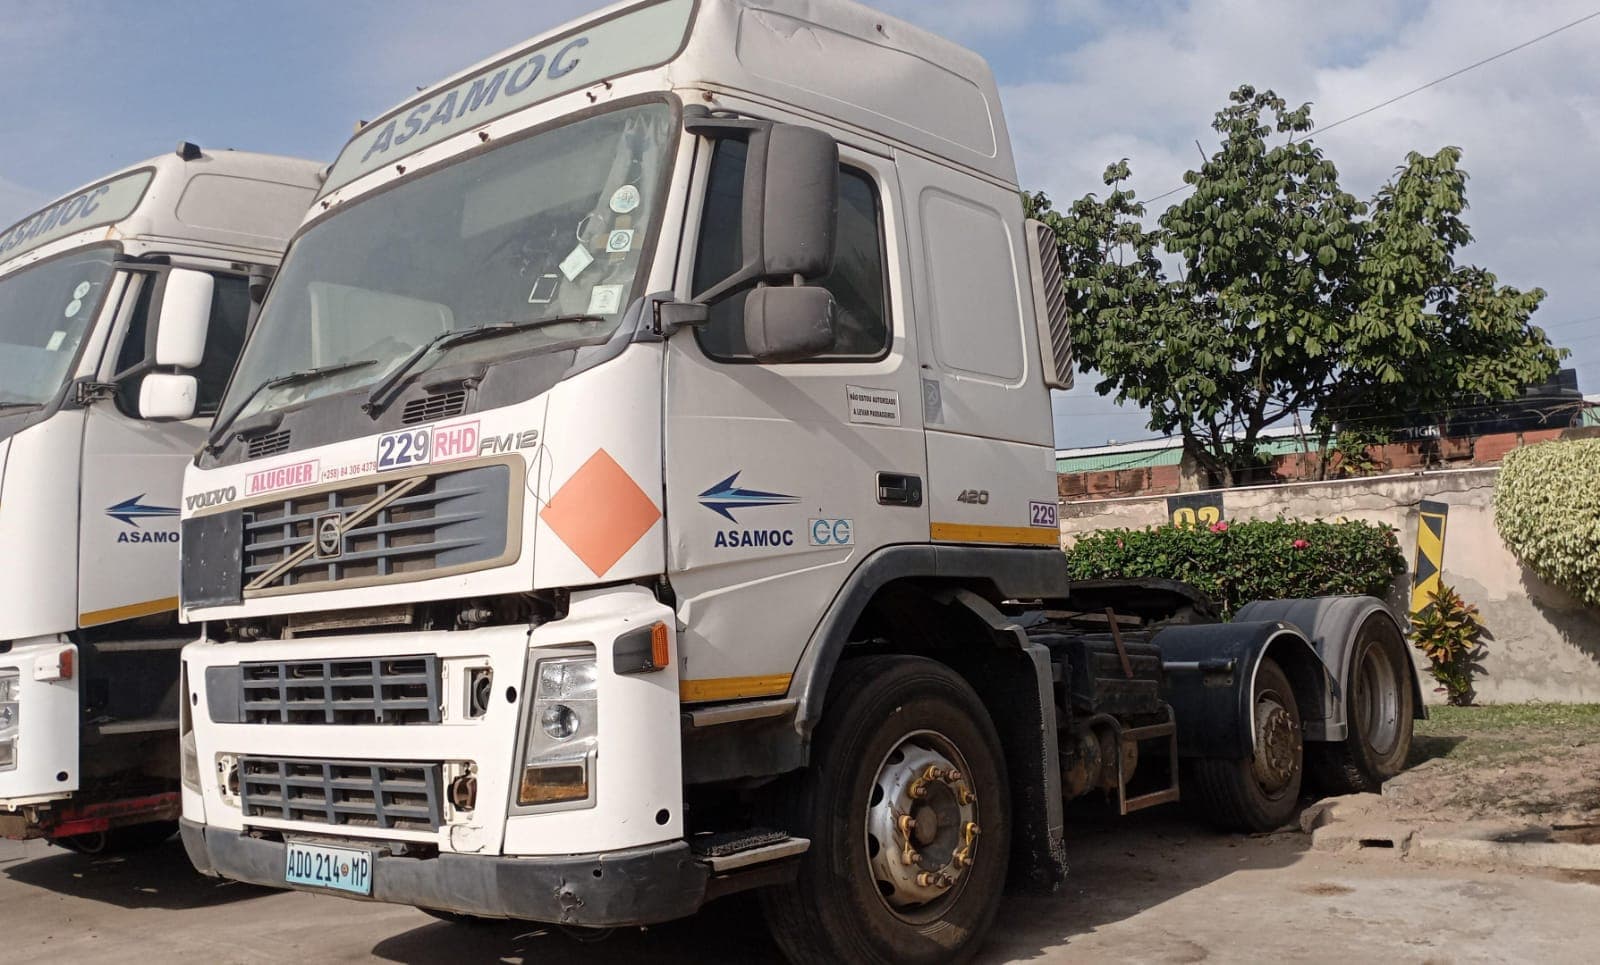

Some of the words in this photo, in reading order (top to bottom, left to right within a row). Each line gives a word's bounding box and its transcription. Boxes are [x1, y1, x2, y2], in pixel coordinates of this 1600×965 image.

[361, 37, 589, 163] ASAMOC
[0, 185, 110, 253] ASAMOC
[379, 430, 430, 467] 229
[435, 427, 476, 458] RHD
[251, 464, 312, 493] ALUGUER
[185, 486, 236, 510] VOLVO
[957, 489, 989, 505] 420
[1032, 504, 1055, 524] 229
[714, 530, 794, 548] ASAMOC
[316, 852, 340, 883] 214
[351, 856, 368, 887] MP
